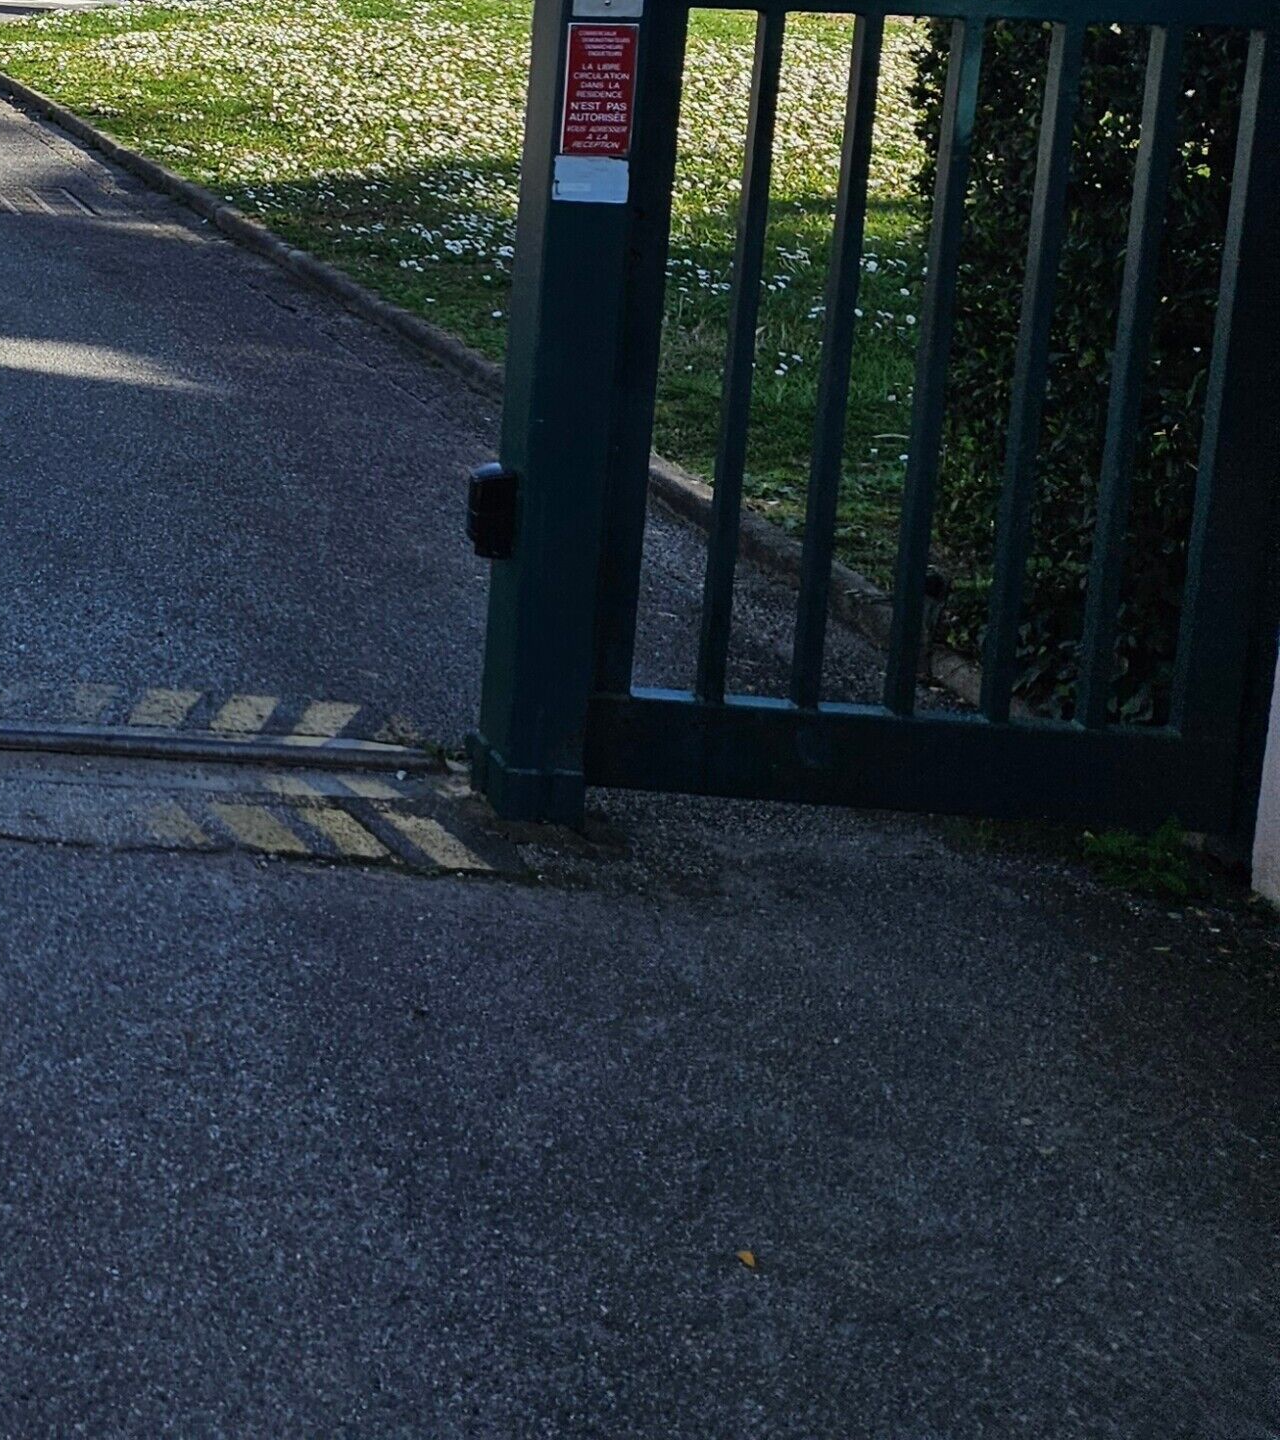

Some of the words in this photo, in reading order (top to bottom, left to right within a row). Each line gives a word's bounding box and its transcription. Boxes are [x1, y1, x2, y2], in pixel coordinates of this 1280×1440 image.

[581, 63, 594, 71] LA
[596, 63, 621, 71] LIBRE
[573, 71, 630, 80] CIRCULATION
[580, 81, 605, 89] DANS
[608, 81, 620, 90] LA
[570, 101, 601, 111] N'EST
[606, 101, 628, 111] PAS
[569, 111, 627, 122] AUTORISÉE
